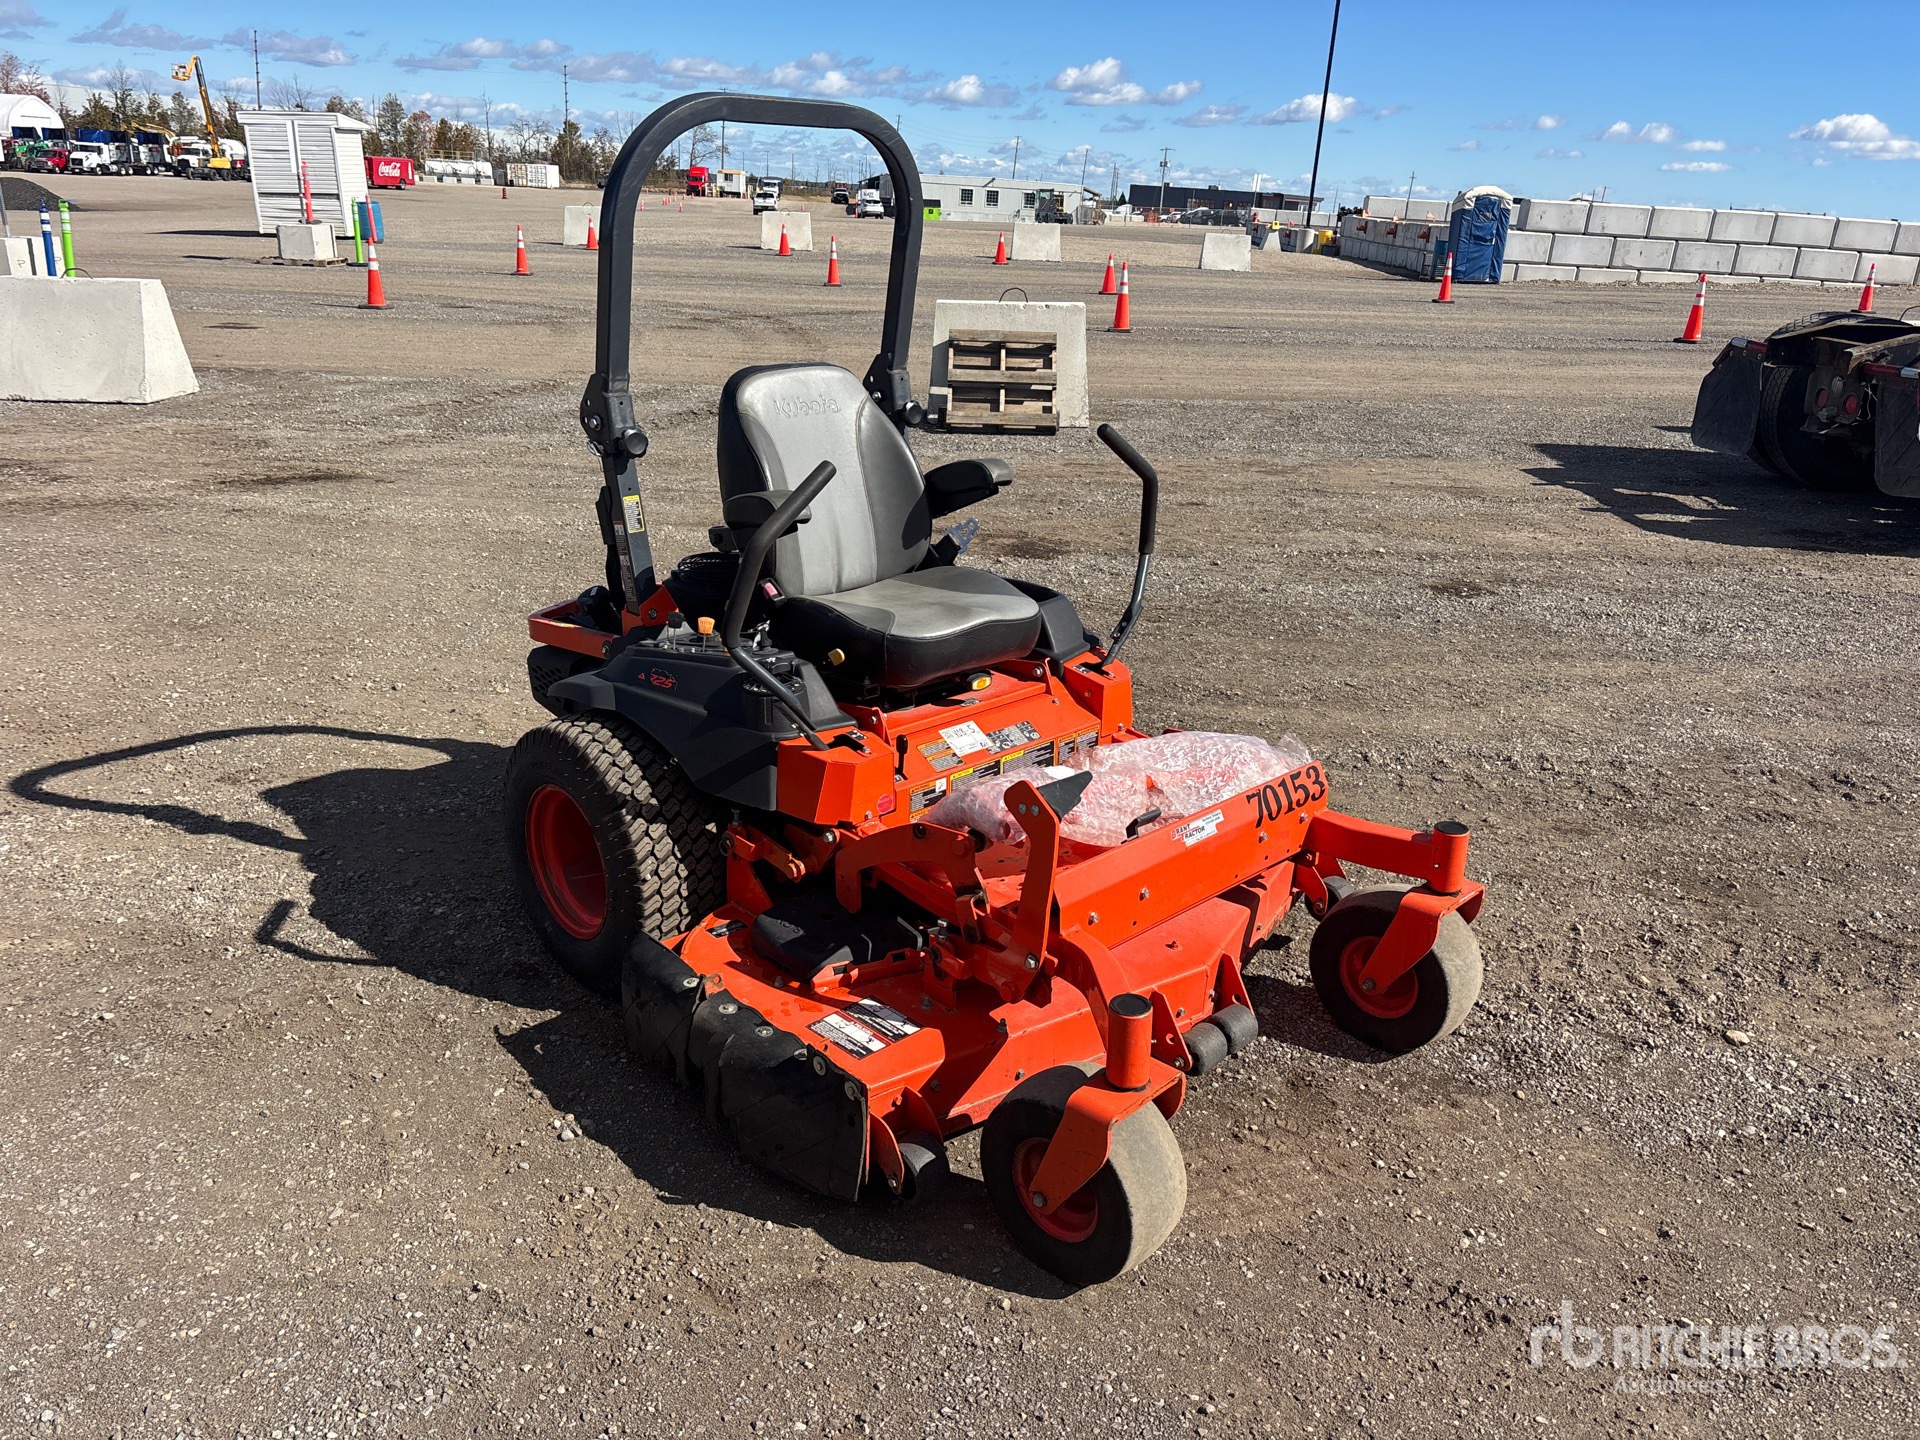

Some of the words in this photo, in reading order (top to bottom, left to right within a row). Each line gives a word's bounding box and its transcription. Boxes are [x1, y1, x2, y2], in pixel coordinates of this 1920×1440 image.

[774, 395, 840, 418] Kubota
[1246, 765, 1326, 828] 70153
[1171, 823, 1190, 840] BRANT
[1181, 825, 1205, 841] TRACTOR
